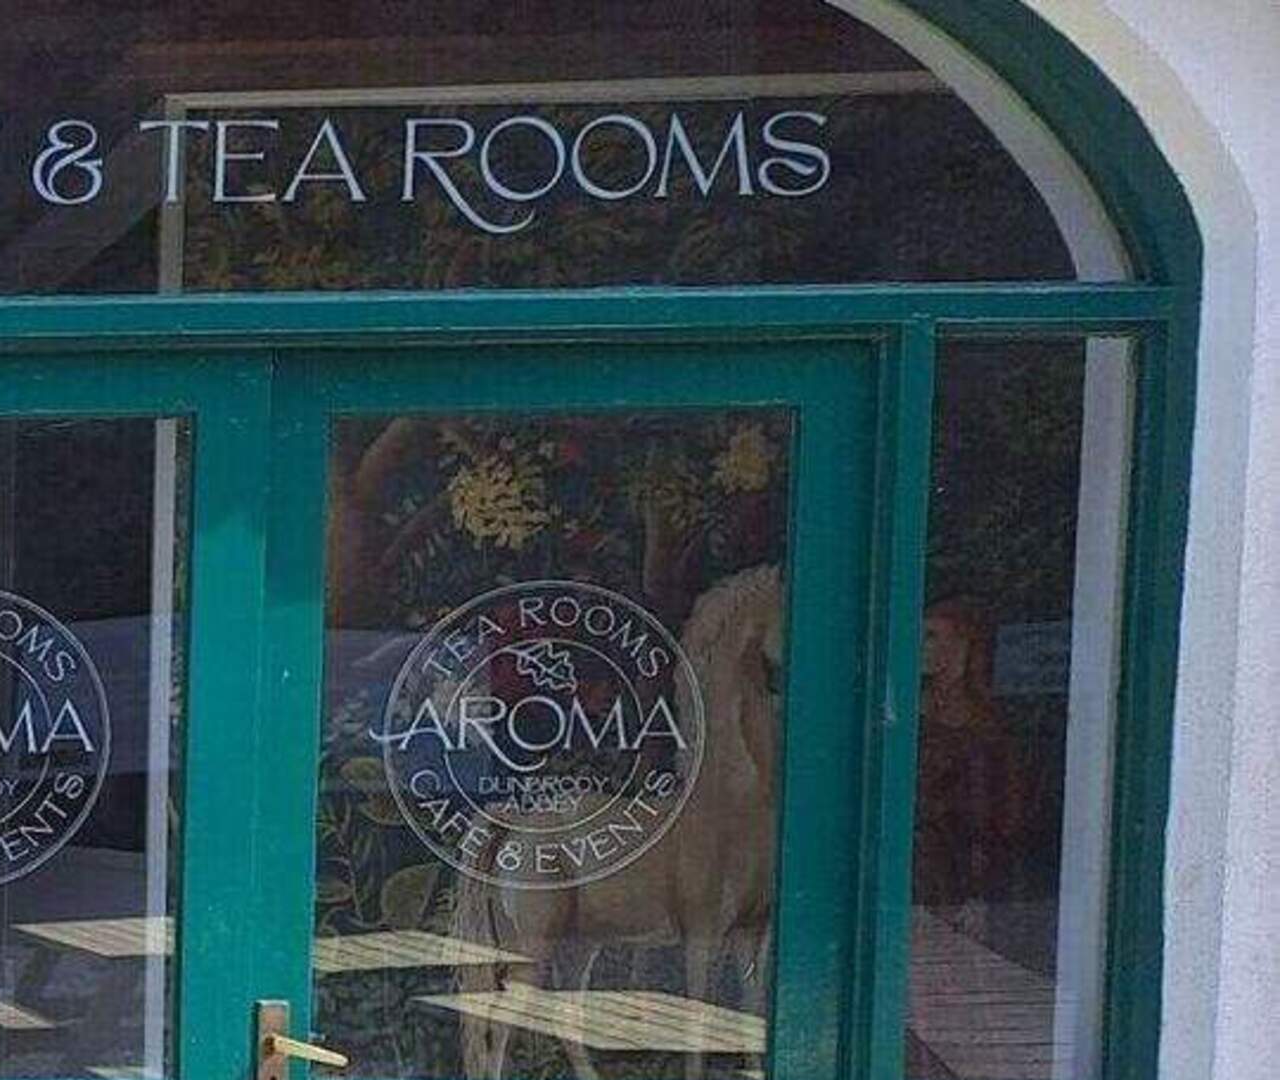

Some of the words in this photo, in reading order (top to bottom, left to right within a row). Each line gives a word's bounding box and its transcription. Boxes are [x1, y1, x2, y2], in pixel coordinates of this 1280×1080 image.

[32, 120, 104, 204] &
[140, 119, 366, 202] TEA
[402, 111, 831, 233] ROOMS
[423, 615, 506, 678] TEA
[519, 597, 671, 678] ROOMS
[369, 695, 687, 771] AROMA
[496, 841, 523, 870] &
[536, 769, 677, 873] EVENTS
